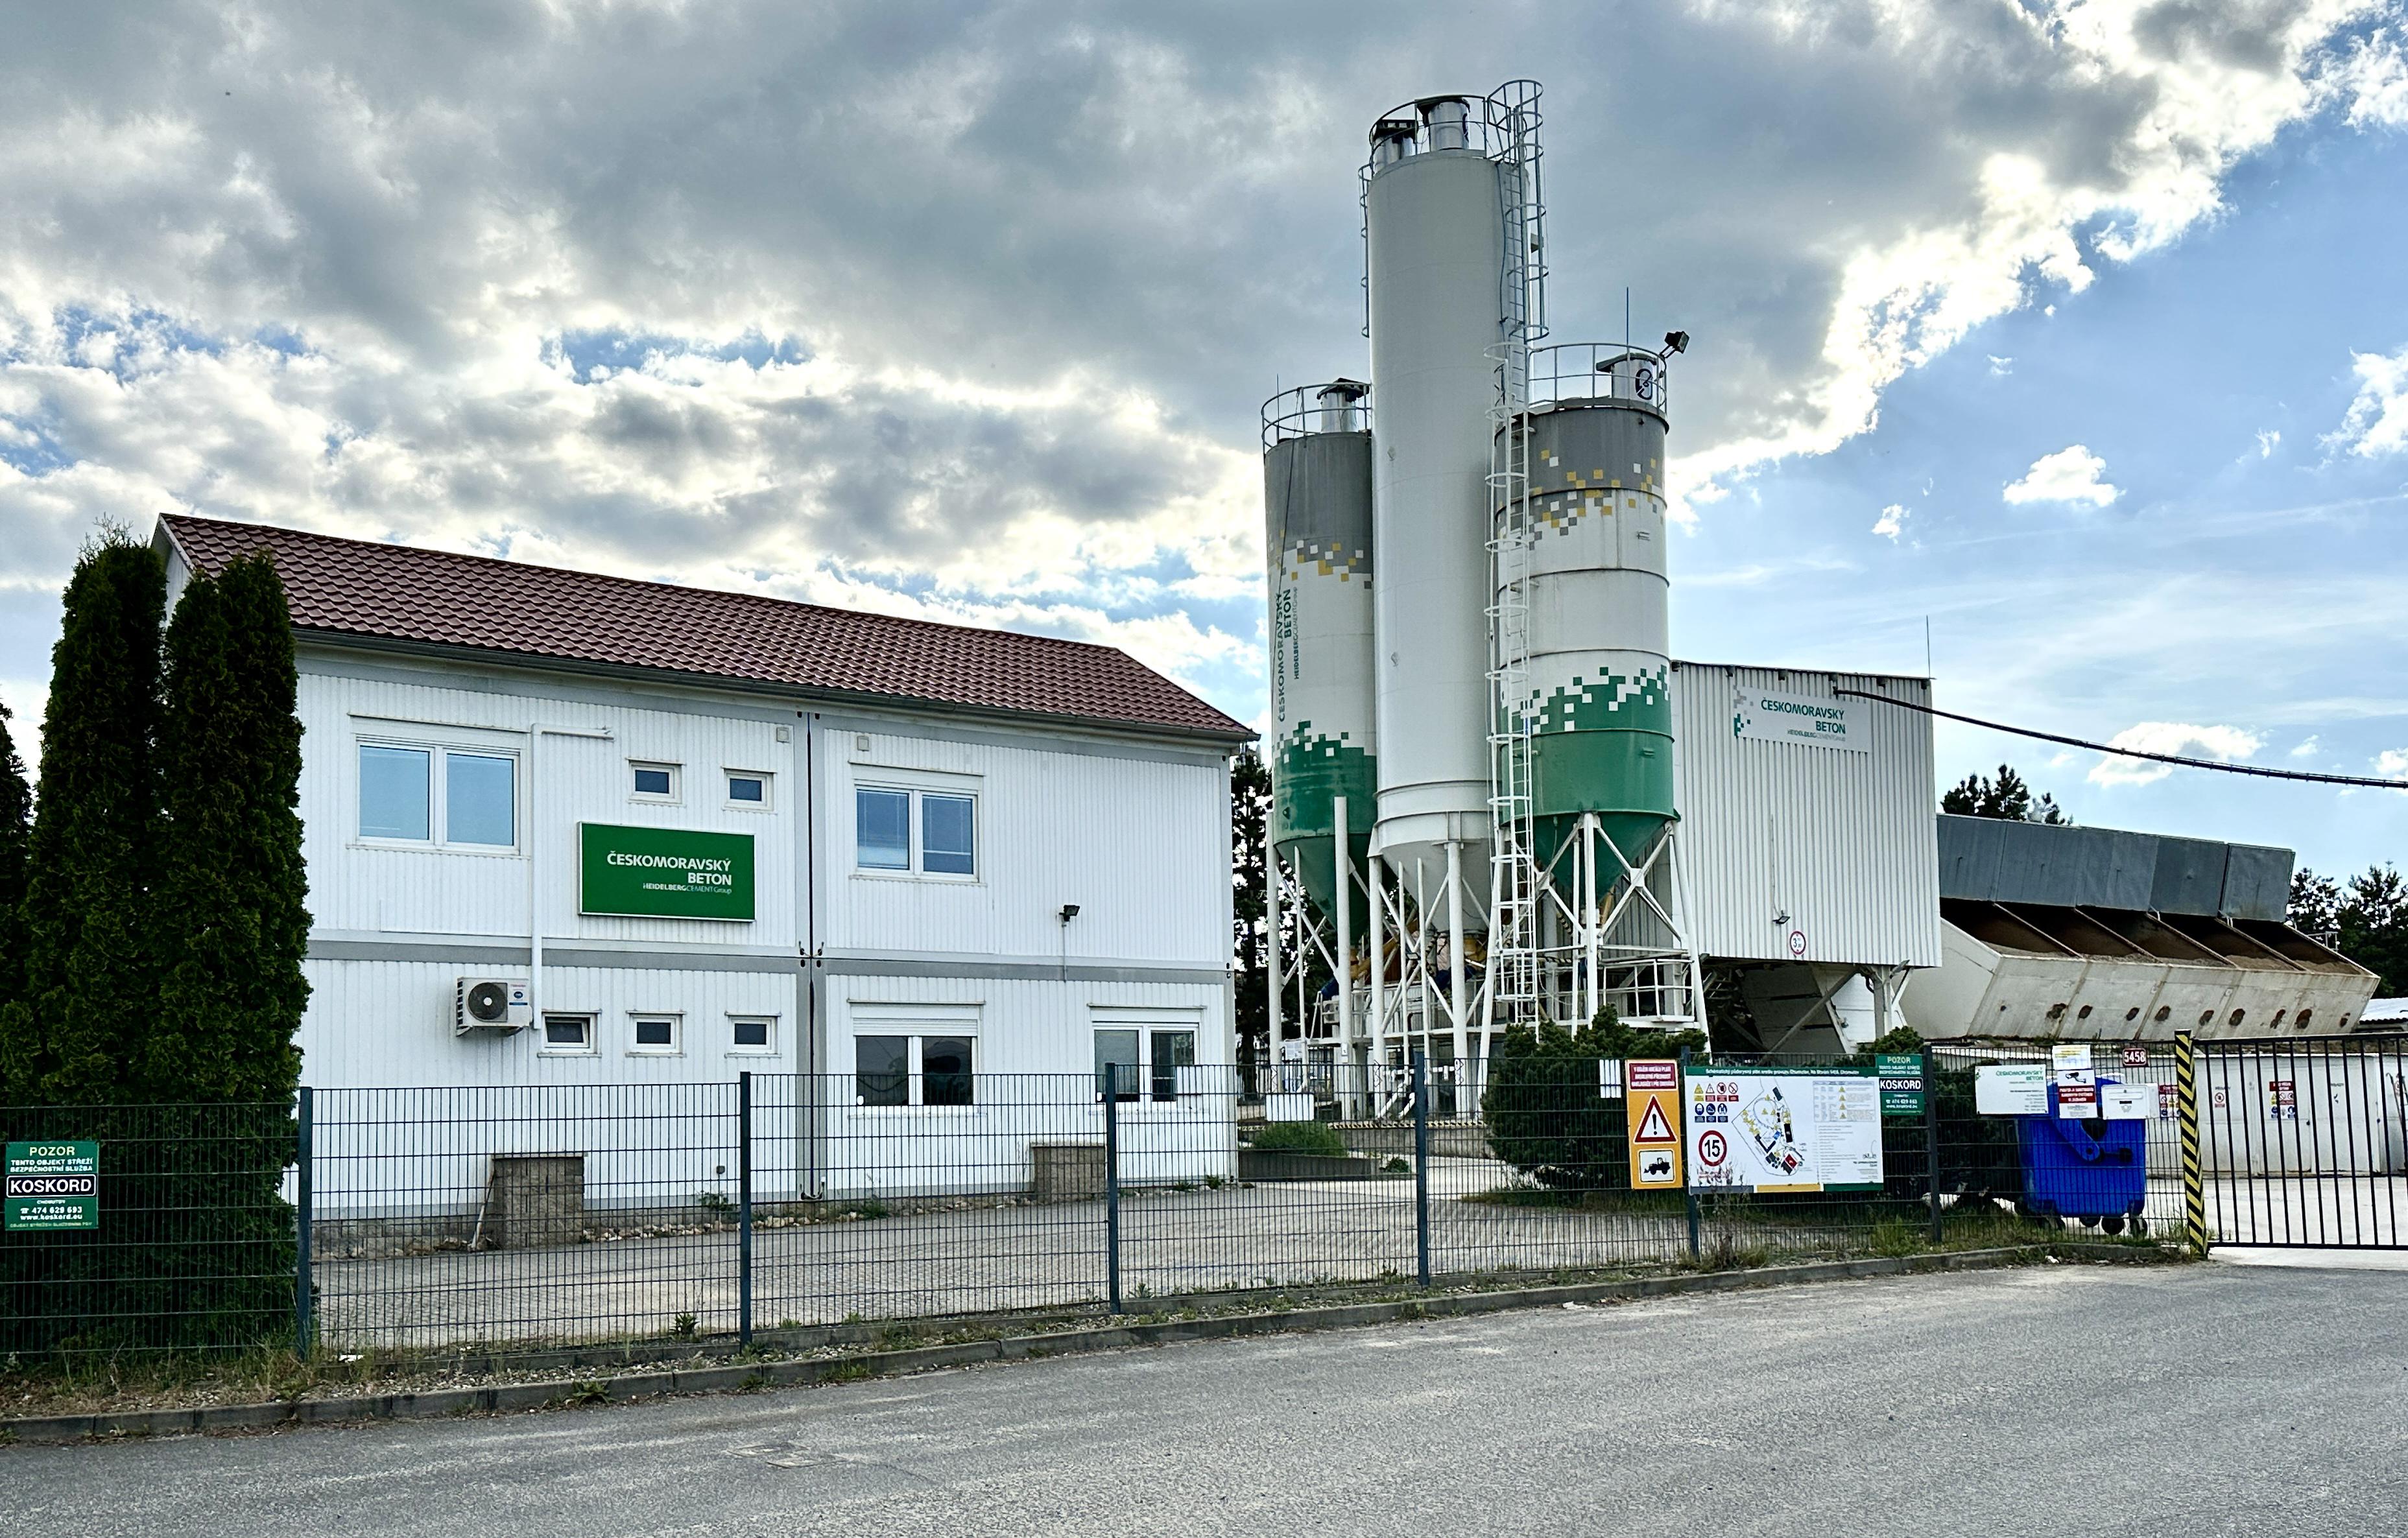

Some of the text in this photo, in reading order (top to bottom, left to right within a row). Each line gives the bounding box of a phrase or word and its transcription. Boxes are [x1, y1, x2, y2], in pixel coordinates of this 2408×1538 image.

[1283, 589, 1292, 638] BETON
[1761, 696, 1845, 720] ČESKOMORAVSKÝ
[1815, 720, 1846, 734] BETON
[606, 850, 732, 871] ČESKOMORAVSKÝ
[687, 872, 732, 885] BETON
[713, 886, 732, 895] Group
[2124, 1051, 2146, 1063] 5458
[1879, 1080, 1922, 1090] KOSKORD
[29, 1146, 75, 1156] POZOR
[1704, 1139, 1720, 1157] 15
[10, 1179, 92, 1193] KOSKORD
